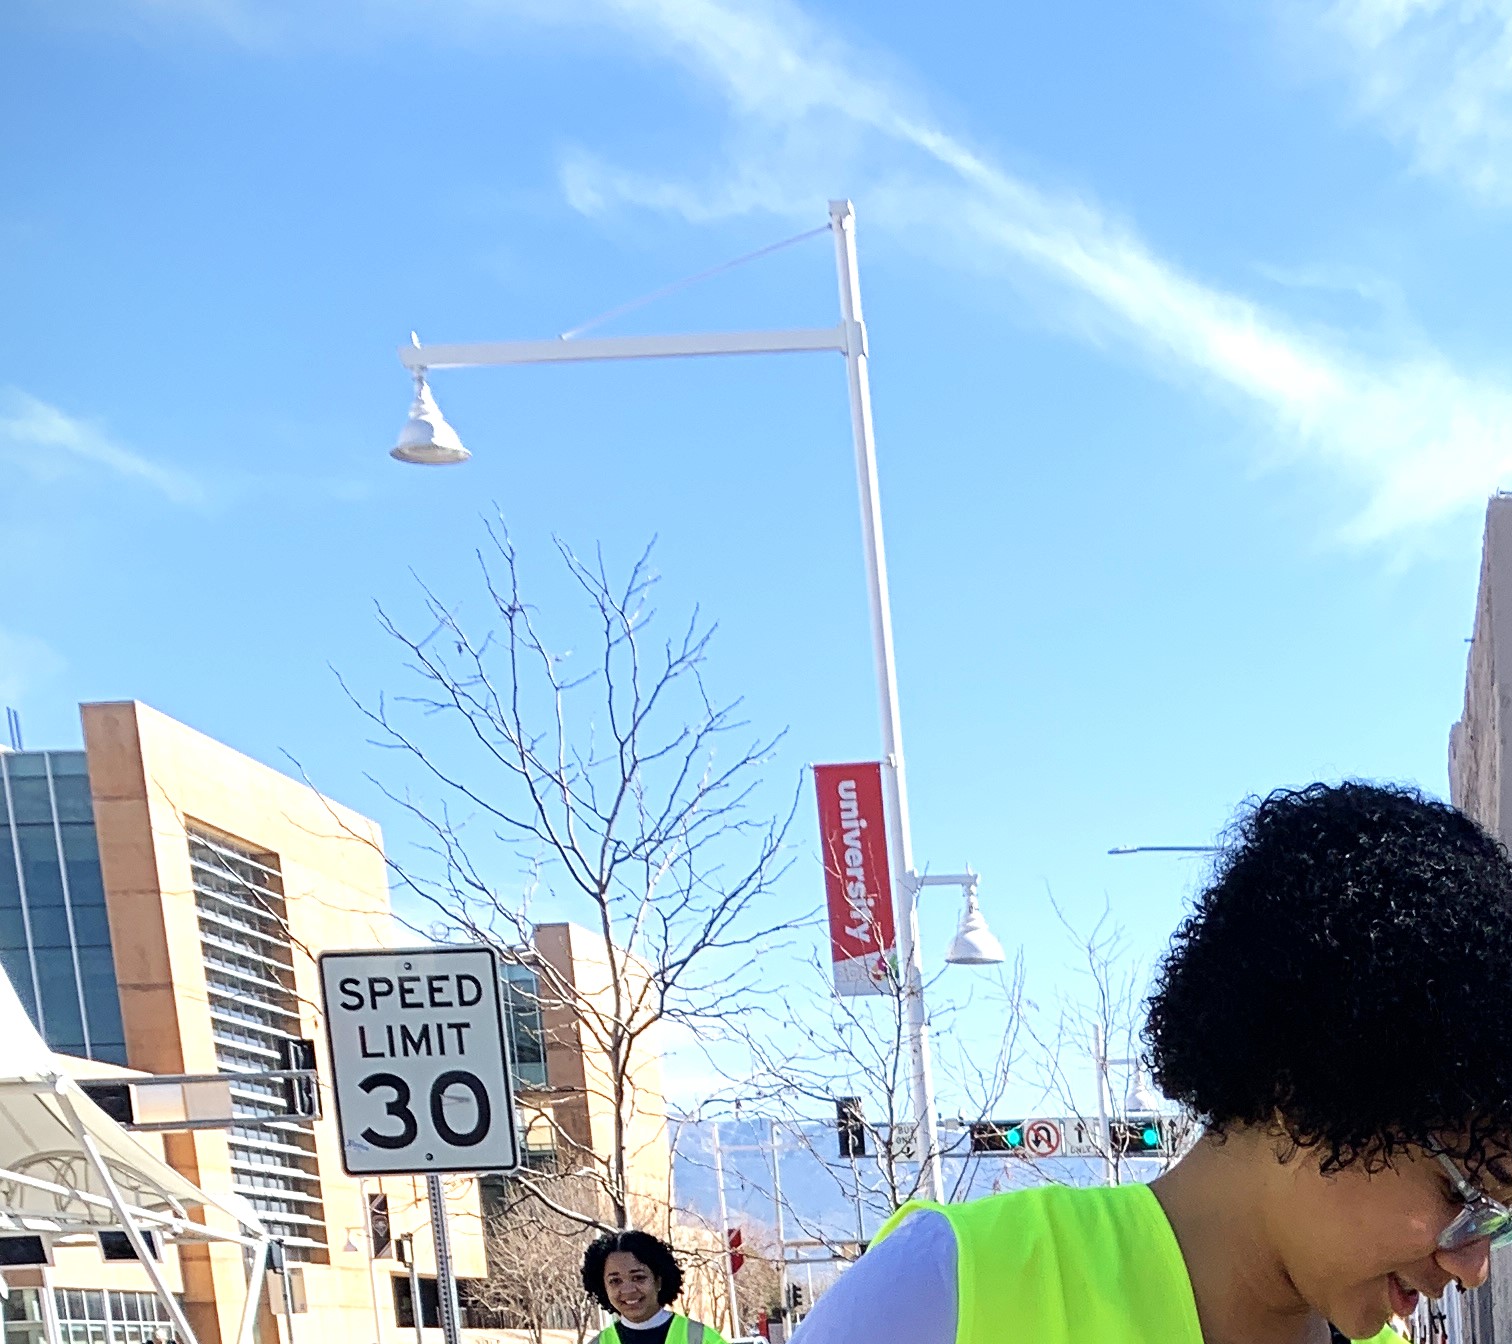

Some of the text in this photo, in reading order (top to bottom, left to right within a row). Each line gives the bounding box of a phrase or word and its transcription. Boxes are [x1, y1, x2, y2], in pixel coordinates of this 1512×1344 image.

[838, 779, 875, 943] university
[339, 974, 482, 1011] SPEED
[358, 1022, 471, 1058] LIMIT
[357, 1070, 491, 1150] 30
[896, 1136, 918, 1146] ONY
[1070, 1144, 1092, 1154] ONLY
